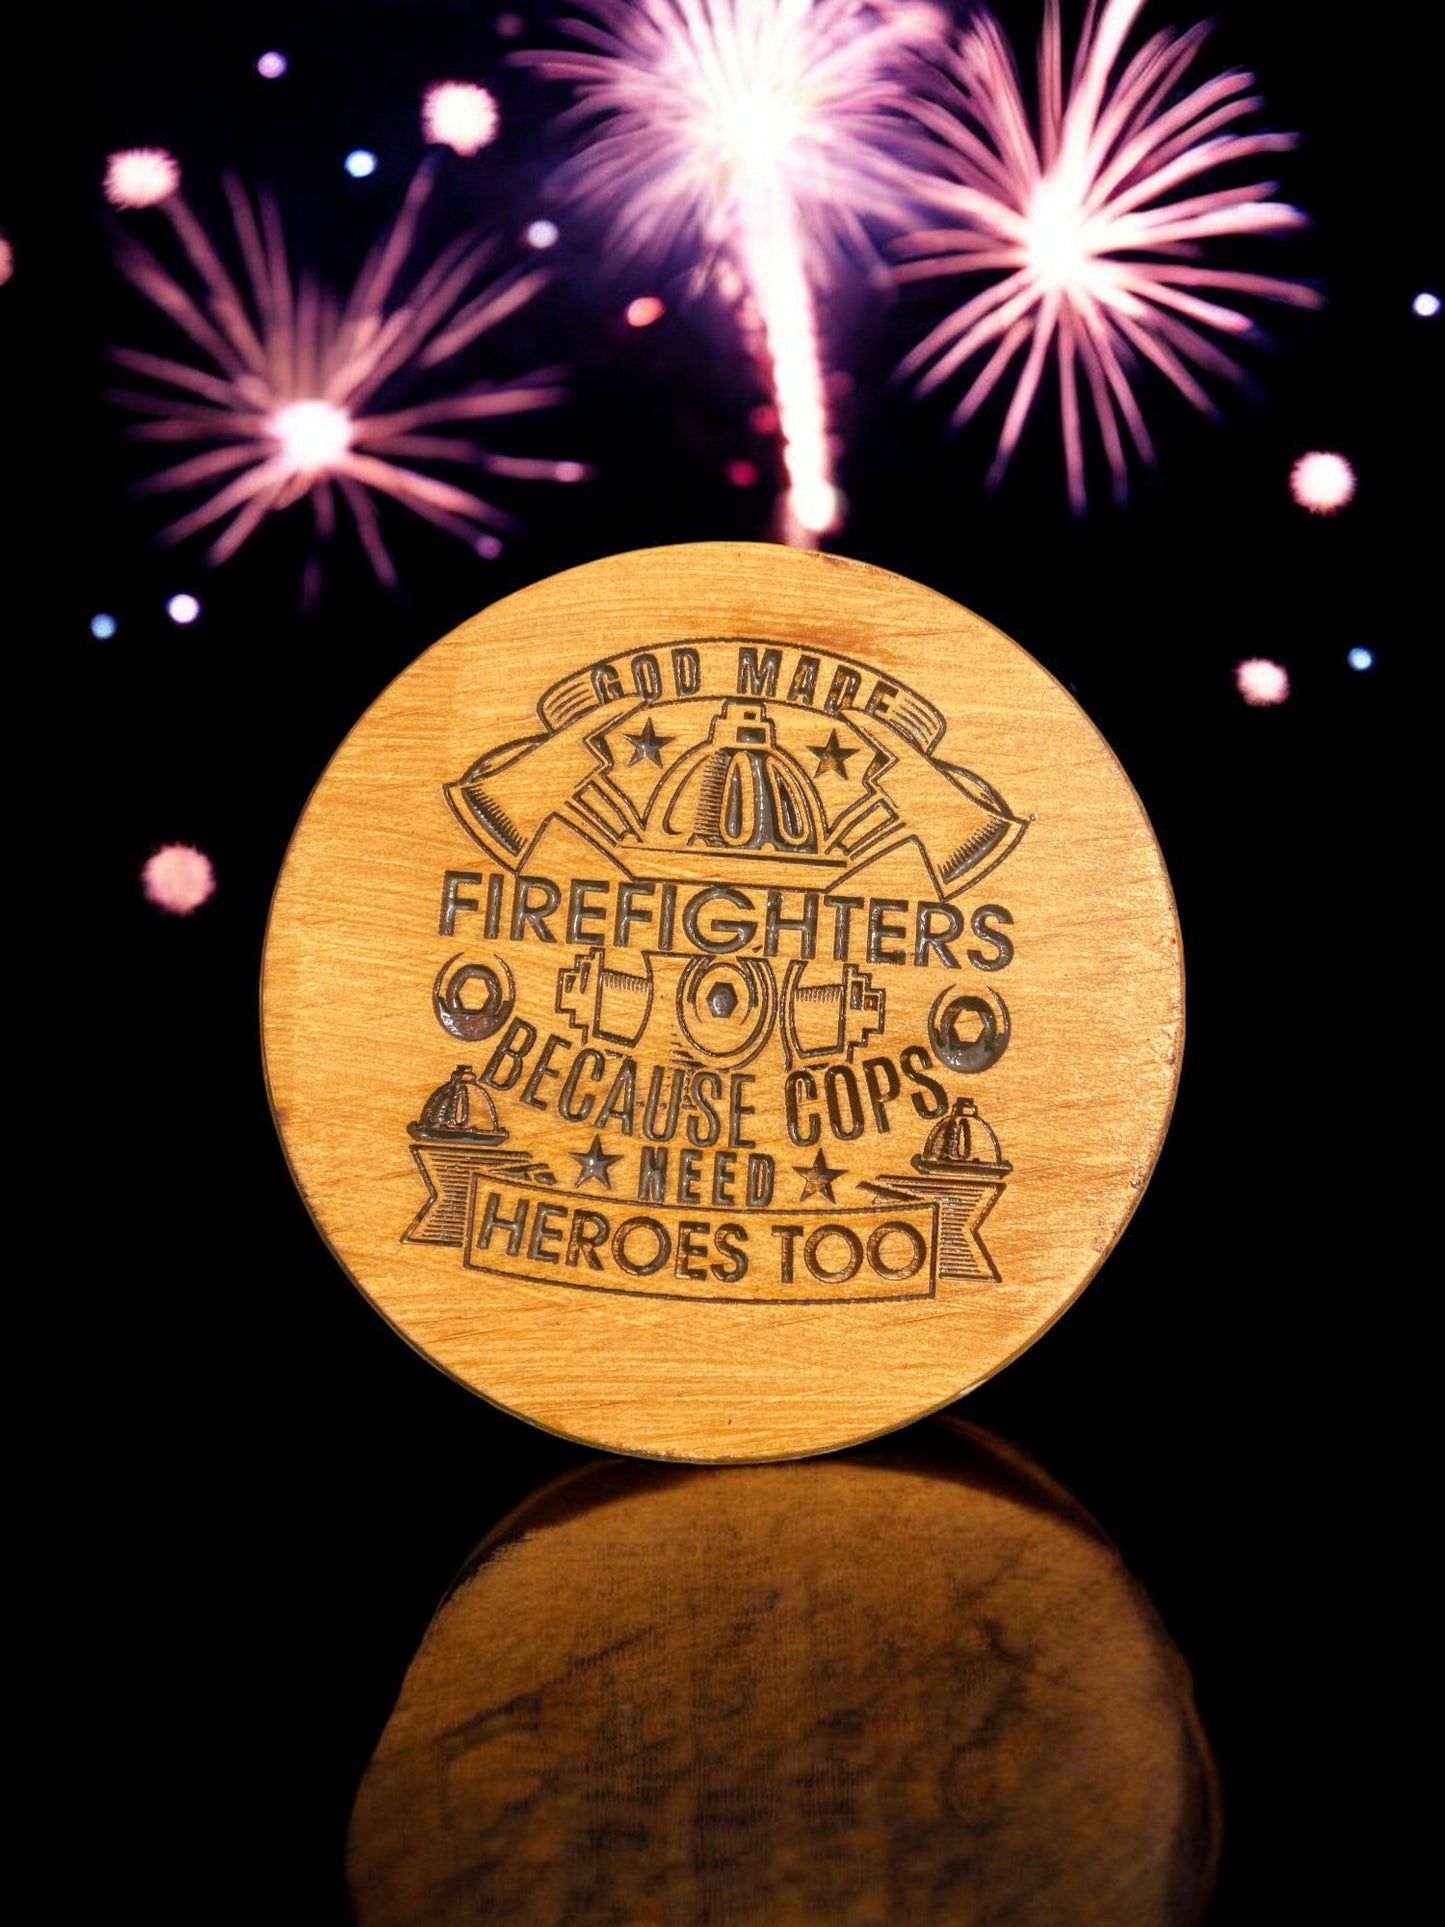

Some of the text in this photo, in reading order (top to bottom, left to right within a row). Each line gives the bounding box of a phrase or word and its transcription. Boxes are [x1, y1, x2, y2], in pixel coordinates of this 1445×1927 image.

[590, 646, 899, 718] GOD MADE
[438, 870, 1014, 971] FIREFIGHTERS
[480, 1017, 949, 1149] BECAUSE COPS
[639, 1146, 775, 1206] NEED
[476, 1193, 926, 1284] HEROES TOO
